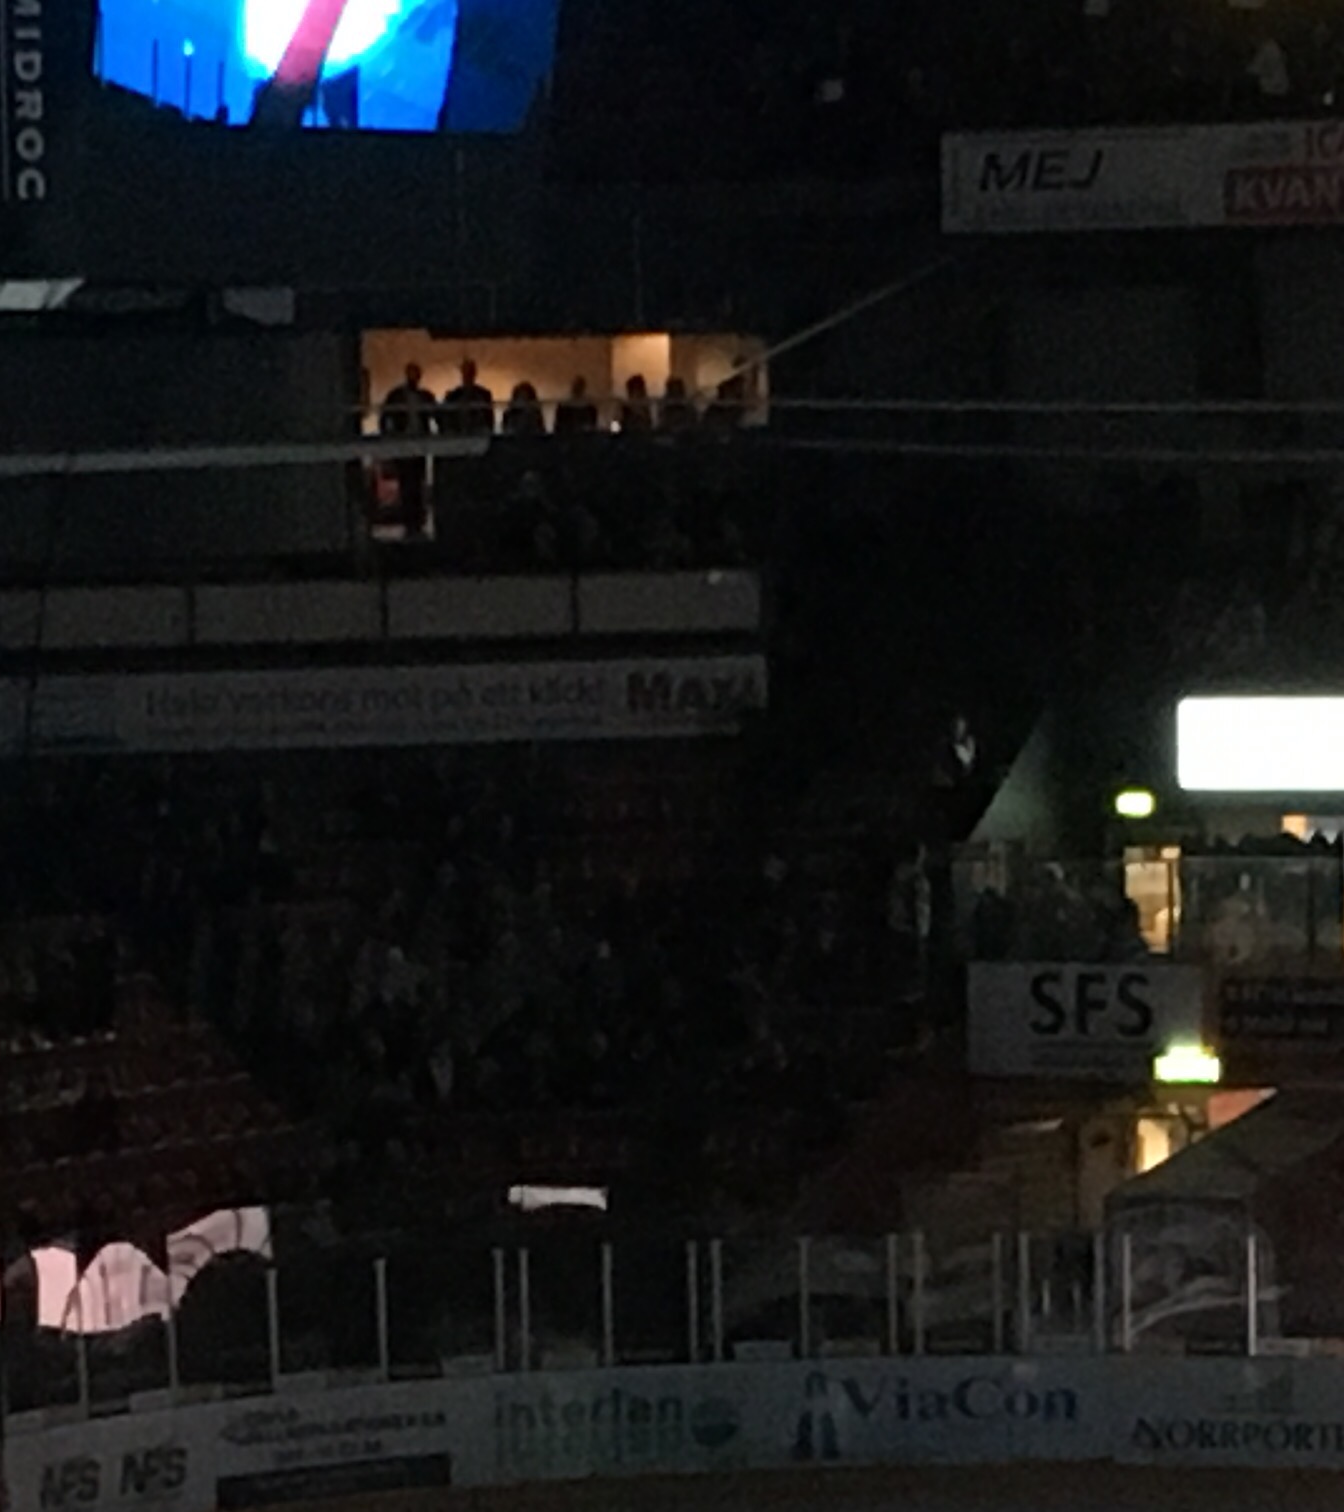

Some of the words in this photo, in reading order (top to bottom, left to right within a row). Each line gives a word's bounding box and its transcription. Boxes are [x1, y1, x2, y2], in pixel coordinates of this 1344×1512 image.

[978, 148, 1105, 194] MEJ
[1028, 970, 1154, 1037] SFS
[837, 1374, 1079, 1421] ViaCon
